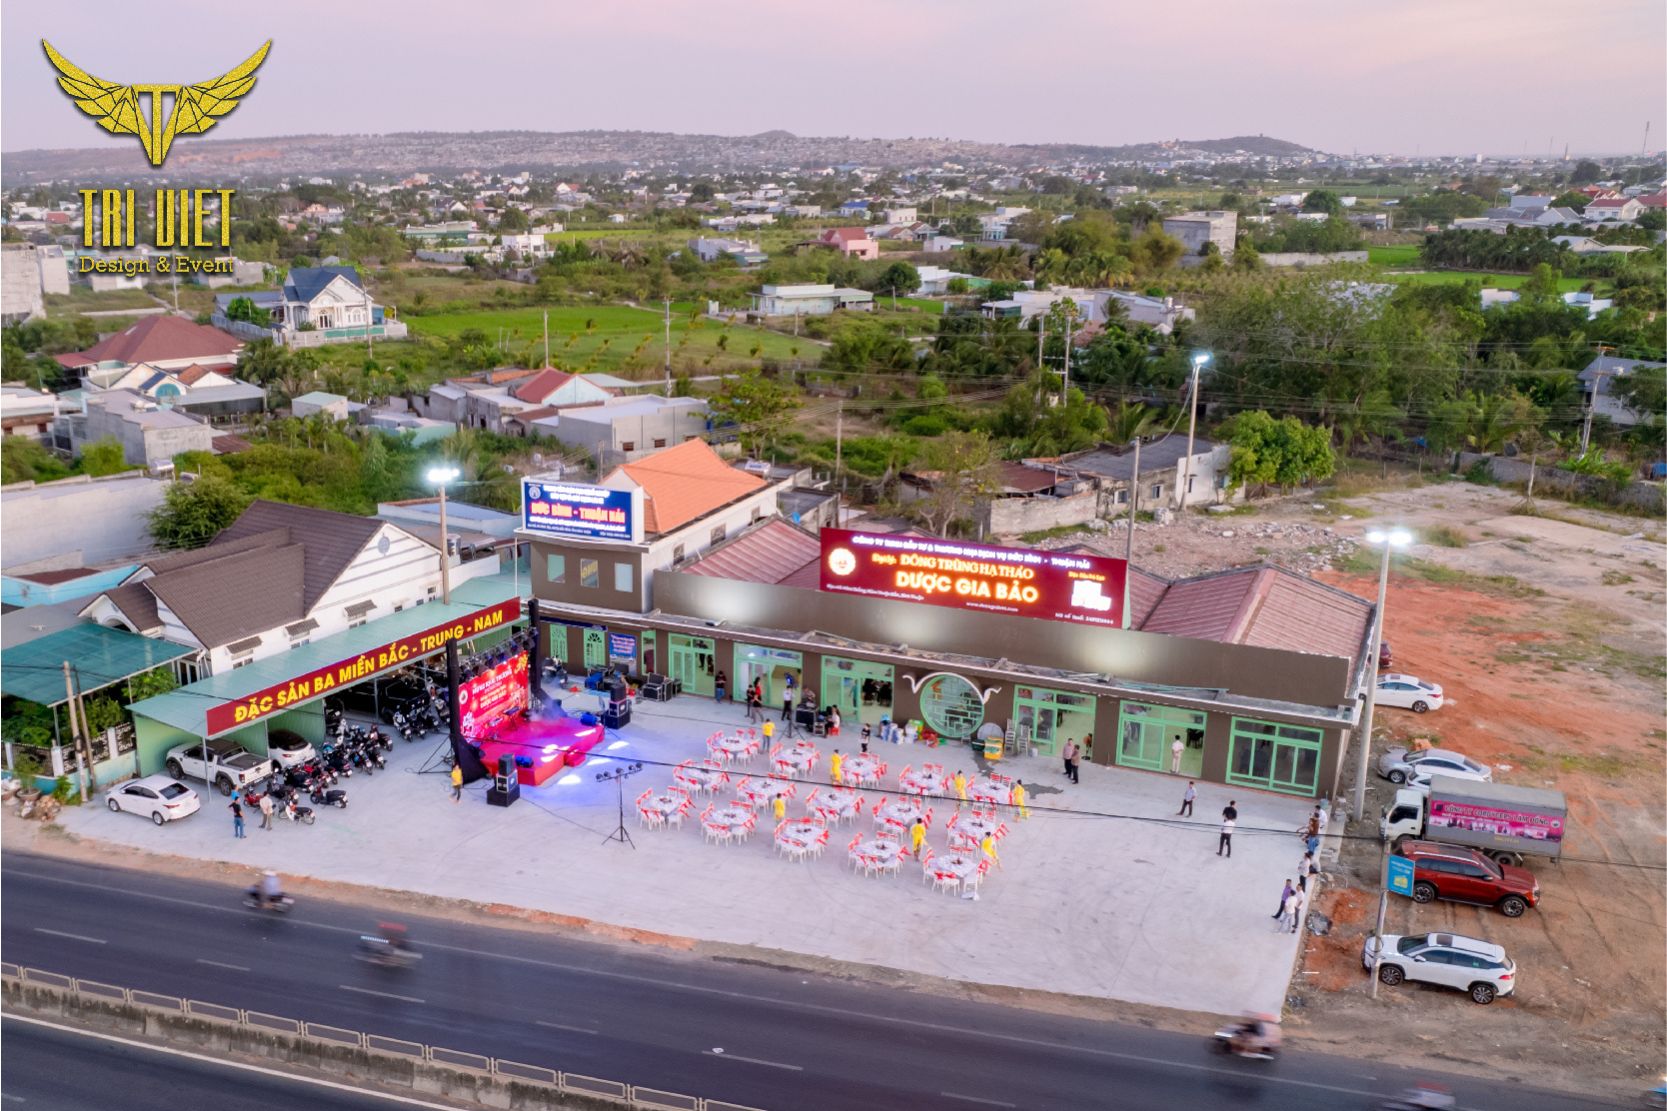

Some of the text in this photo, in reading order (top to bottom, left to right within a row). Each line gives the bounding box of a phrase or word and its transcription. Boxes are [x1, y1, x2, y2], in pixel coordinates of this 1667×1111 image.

[900, 553, 936, 569] ĐÔNG
[938, 557, 979, 573] TRÙNG
[979, 564, 998, 577] HẠ
[896, 570, 952, 594] DƯỢC
[955, 578, 991, 597] GIA
[995, 580, 1039, 603] BẢO
[234, 696, 272, 722] ĐẶC
[276, 679, 310, 703] SẢN
[314, 676, 335, 695] BA
[339, 655, 375, 682] MIỀN
[378, 645, 409, 667] BẮC
[420, 626, 464, 651] TRUNG
[474, 610, 503, 631] NAM
